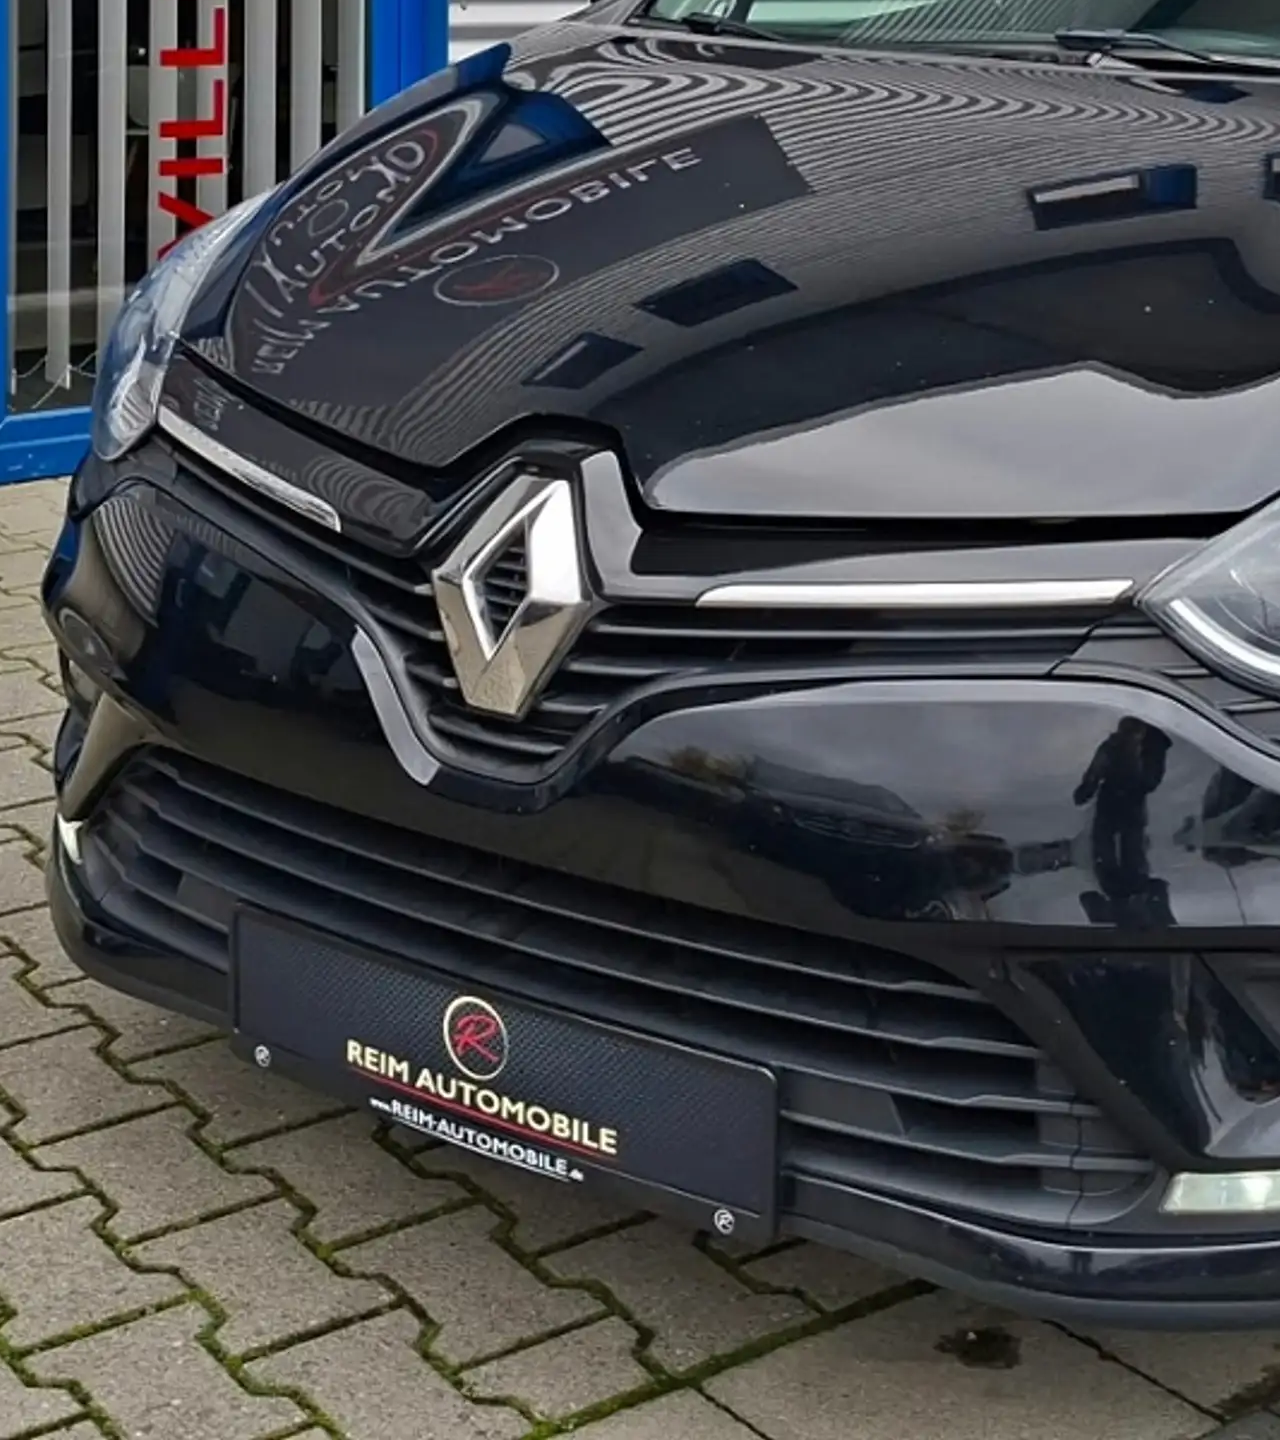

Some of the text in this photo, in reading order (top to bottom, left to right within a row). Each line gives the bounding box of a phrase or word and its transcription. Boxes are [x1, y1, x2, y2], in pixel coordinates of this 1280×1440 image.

[453, 1013, 500, 1063] R
[345, 1039, 618, 1156] REIM AUTOMOBILE
